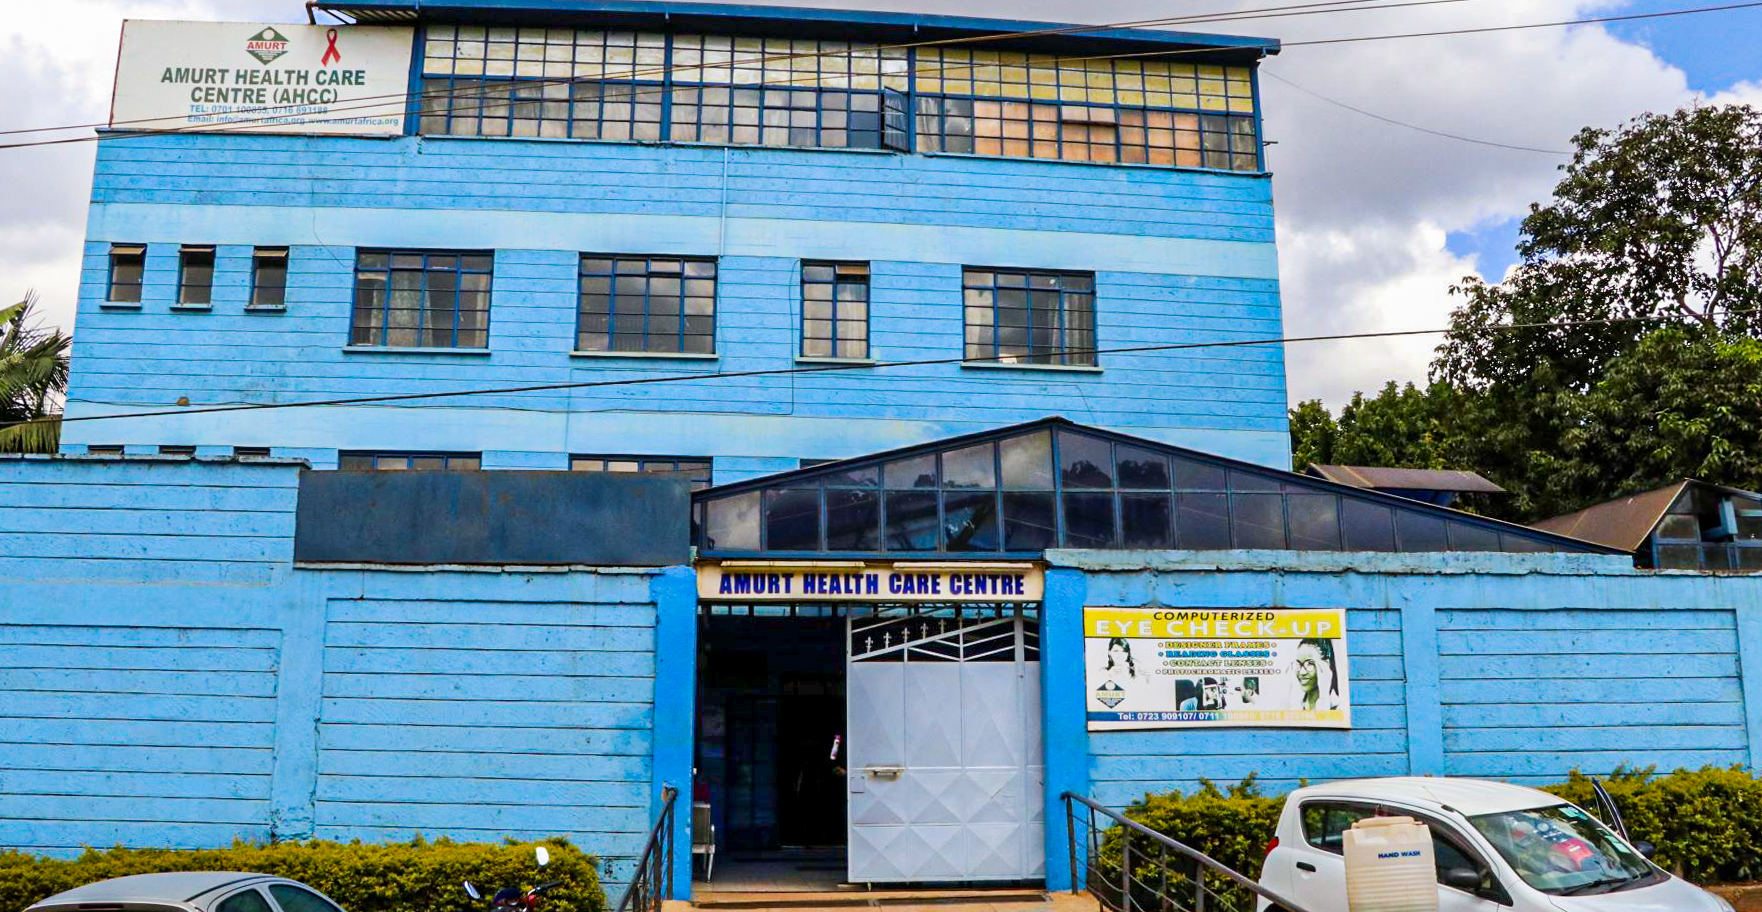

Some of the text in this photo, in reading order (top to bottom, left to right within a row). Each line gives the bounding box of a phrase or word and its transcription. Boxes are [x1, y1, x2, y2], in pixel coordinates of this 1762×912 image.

[247, 41, 288, 50] AMURT
[160, 67, 366, 86] AMURT HEALTH CARE
[190, 86, 338, 104] CENTRE (AHCC)
[189, 104, 209, 113] TEL:
[211, 104, 233, 114] 0701
[719, 573, 1025, 595] AMURT HEALTH CARE CENTRE
[1153, 611, 1275, 622] COMPUTERIZED
[1096, 619, 1332, 636] EYE CHECK-UP
[1165, 641, 1270, 649] DESIGNER FRAMES
[1166, 650, 1270, 658] READING GLASSES
[1169, 659, 1267, 667] CONTACT LENSES
[1118, 712, 1135, 721] Tel:
[1137, 712, 1159, 721] 0723
[1199, 712, 1220, 721] 0711
[1378, 851, 1400, 859] HAND
